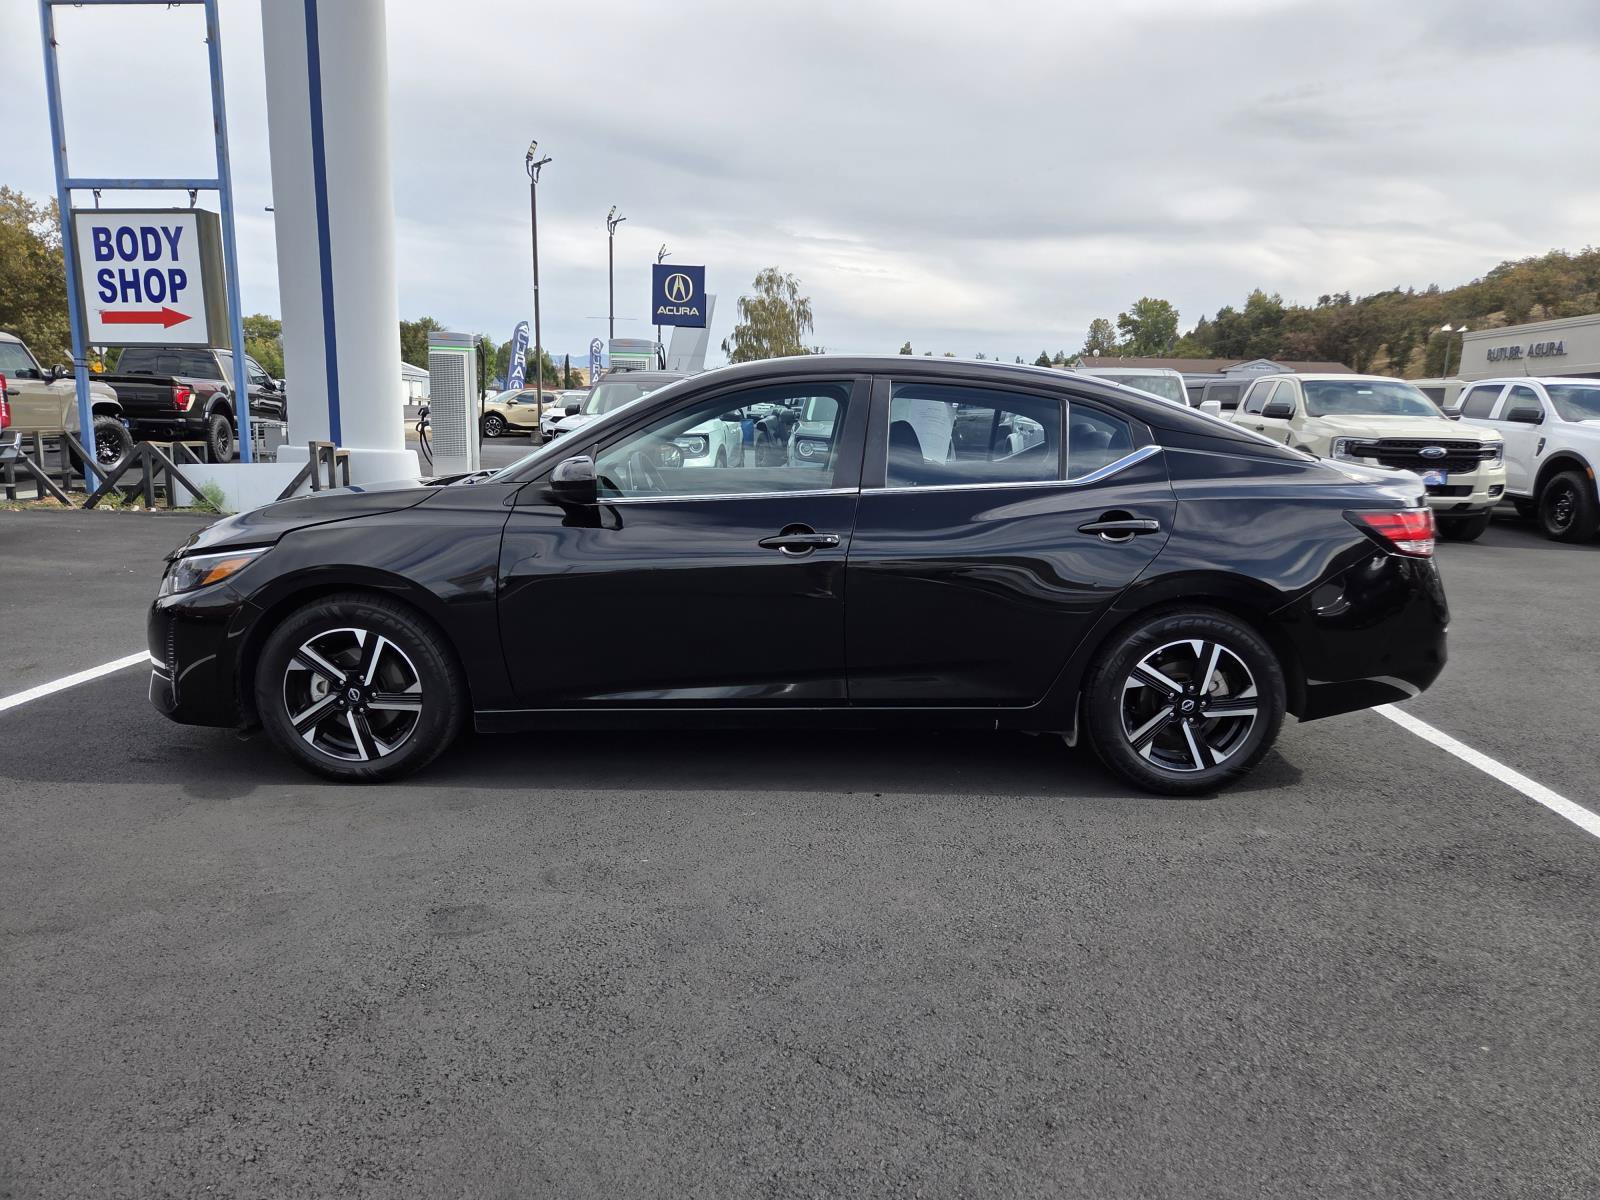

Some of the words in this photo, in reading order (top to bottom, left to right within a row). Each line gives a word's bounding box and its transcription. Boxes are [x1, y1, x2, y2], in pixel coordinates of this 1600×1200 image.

[92, 226, 183, 262] BODY
[97, 268, 187, 303] SHOP
[657, 305, 700, 316] ACURA
[512, 324, 529, 380] ACURA
[1487, 345, 1522, 362] BUTLER
[1527, 340, 1565, 357] ACURA
